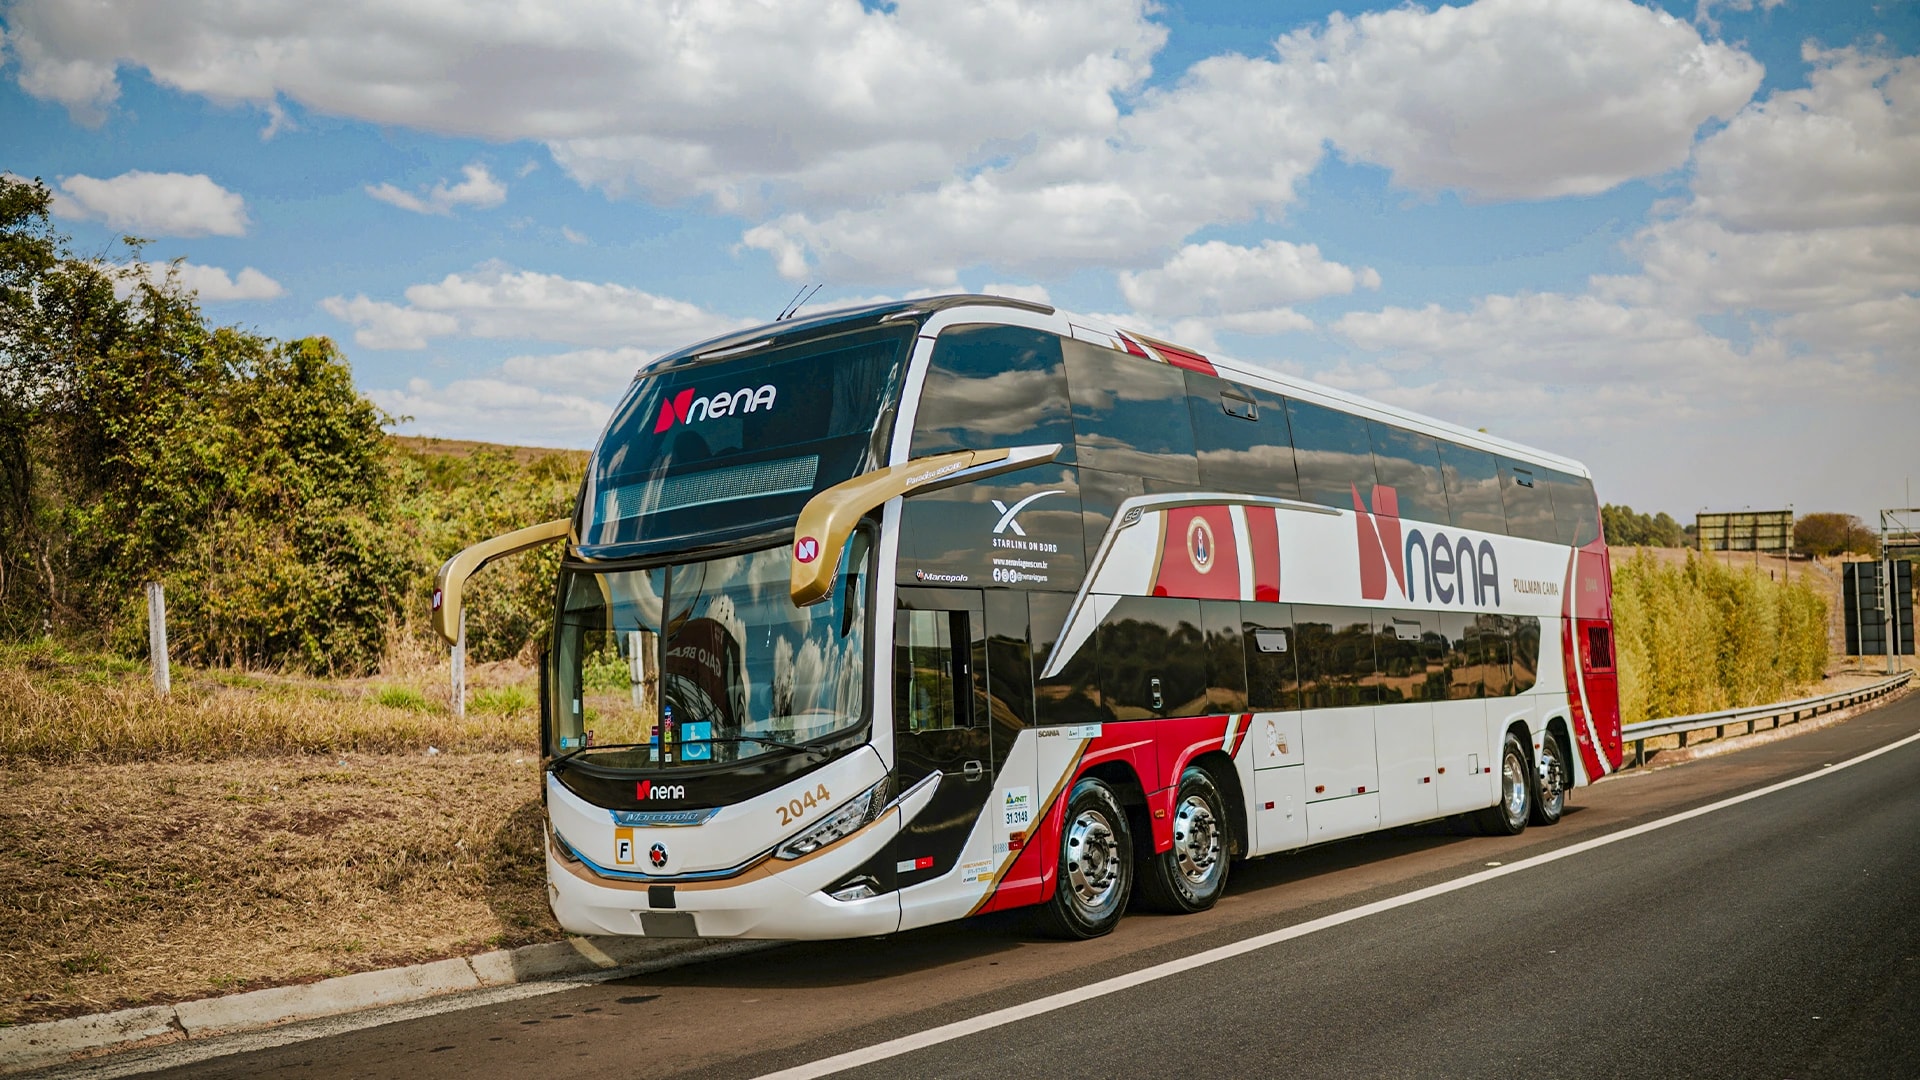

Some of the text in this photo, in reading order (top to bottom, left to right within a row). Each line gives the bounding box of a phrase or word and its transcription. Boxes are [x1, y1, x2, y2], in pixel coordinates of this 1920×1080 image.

[992, 538, 1058, 552] STARLINK ON BORD
[923, 573, 969, 582] Marcopolo
[1513, 578, 1559, 595] PULLMAN CAMA
[1037, 730, 1060, 738] SCANIA
[775, 783, 831, 826] 2044
[626, 812, 699, 822] Marcopolo
[1005, 812, 1013, 825] 31
[619, 842, 629, 859] F
